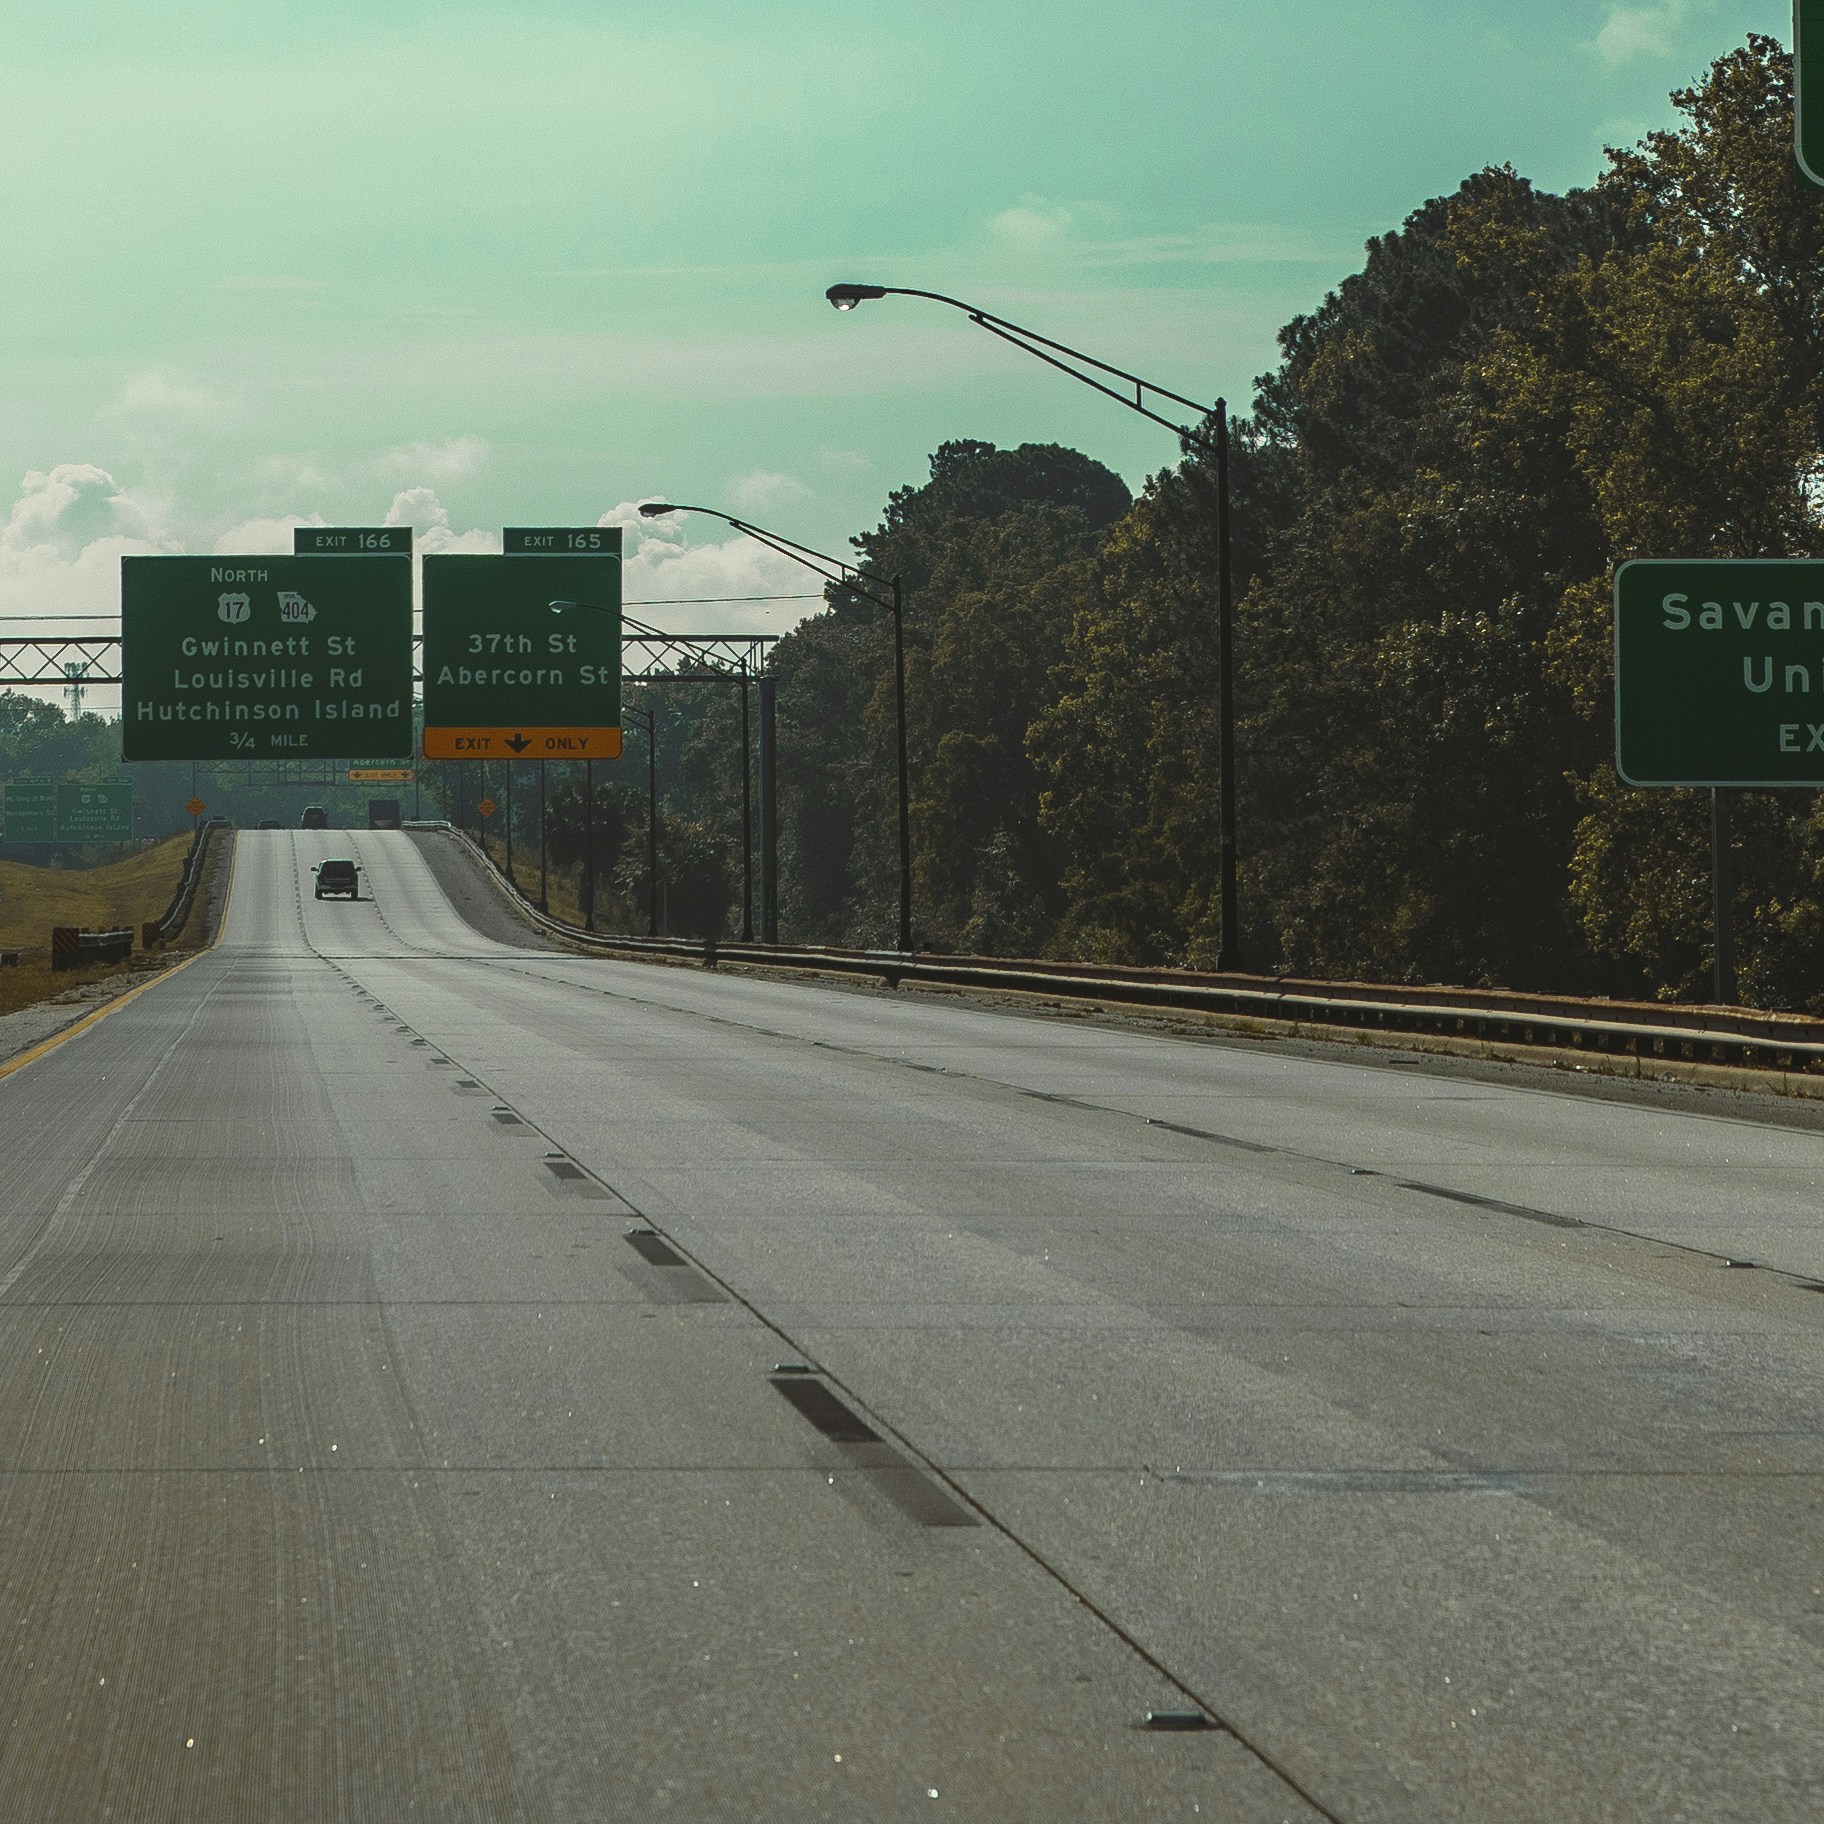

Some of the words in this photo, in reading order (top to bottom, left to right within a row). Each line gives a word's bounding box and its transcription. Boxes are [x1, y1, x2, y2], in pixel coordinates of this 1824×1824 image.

[315, 535, 347, 547] EXIT
[358, 533, 391, 549] 166
[524, 535, 554, 547] EXIT
[567, 533, 601, 549] 165
[210, 567, 268, 583] NORTH
[225, 601, 245, 619] 17
[282, 601, 309, 620] 404
[181, 636, 310, 657] Gwinnett
[327, 635, 356, 656] St
[468, 633, 532, 654] 37th
[548, 633, 577, 654] St
[174, 668, 314, 689] Louisville
[330, 668, 362, 688] Rd
[436, 665, 563, 685] Abercorn
[579, 665, 609, 685] St
[137, 700, 299, 721] Hutchinson
[315, 699, 400, 719] Island
[270, 734, 308, 747] MILE
[455, 737, 491, 750] EXIT
[545, 737, 589, 750] ONLY
